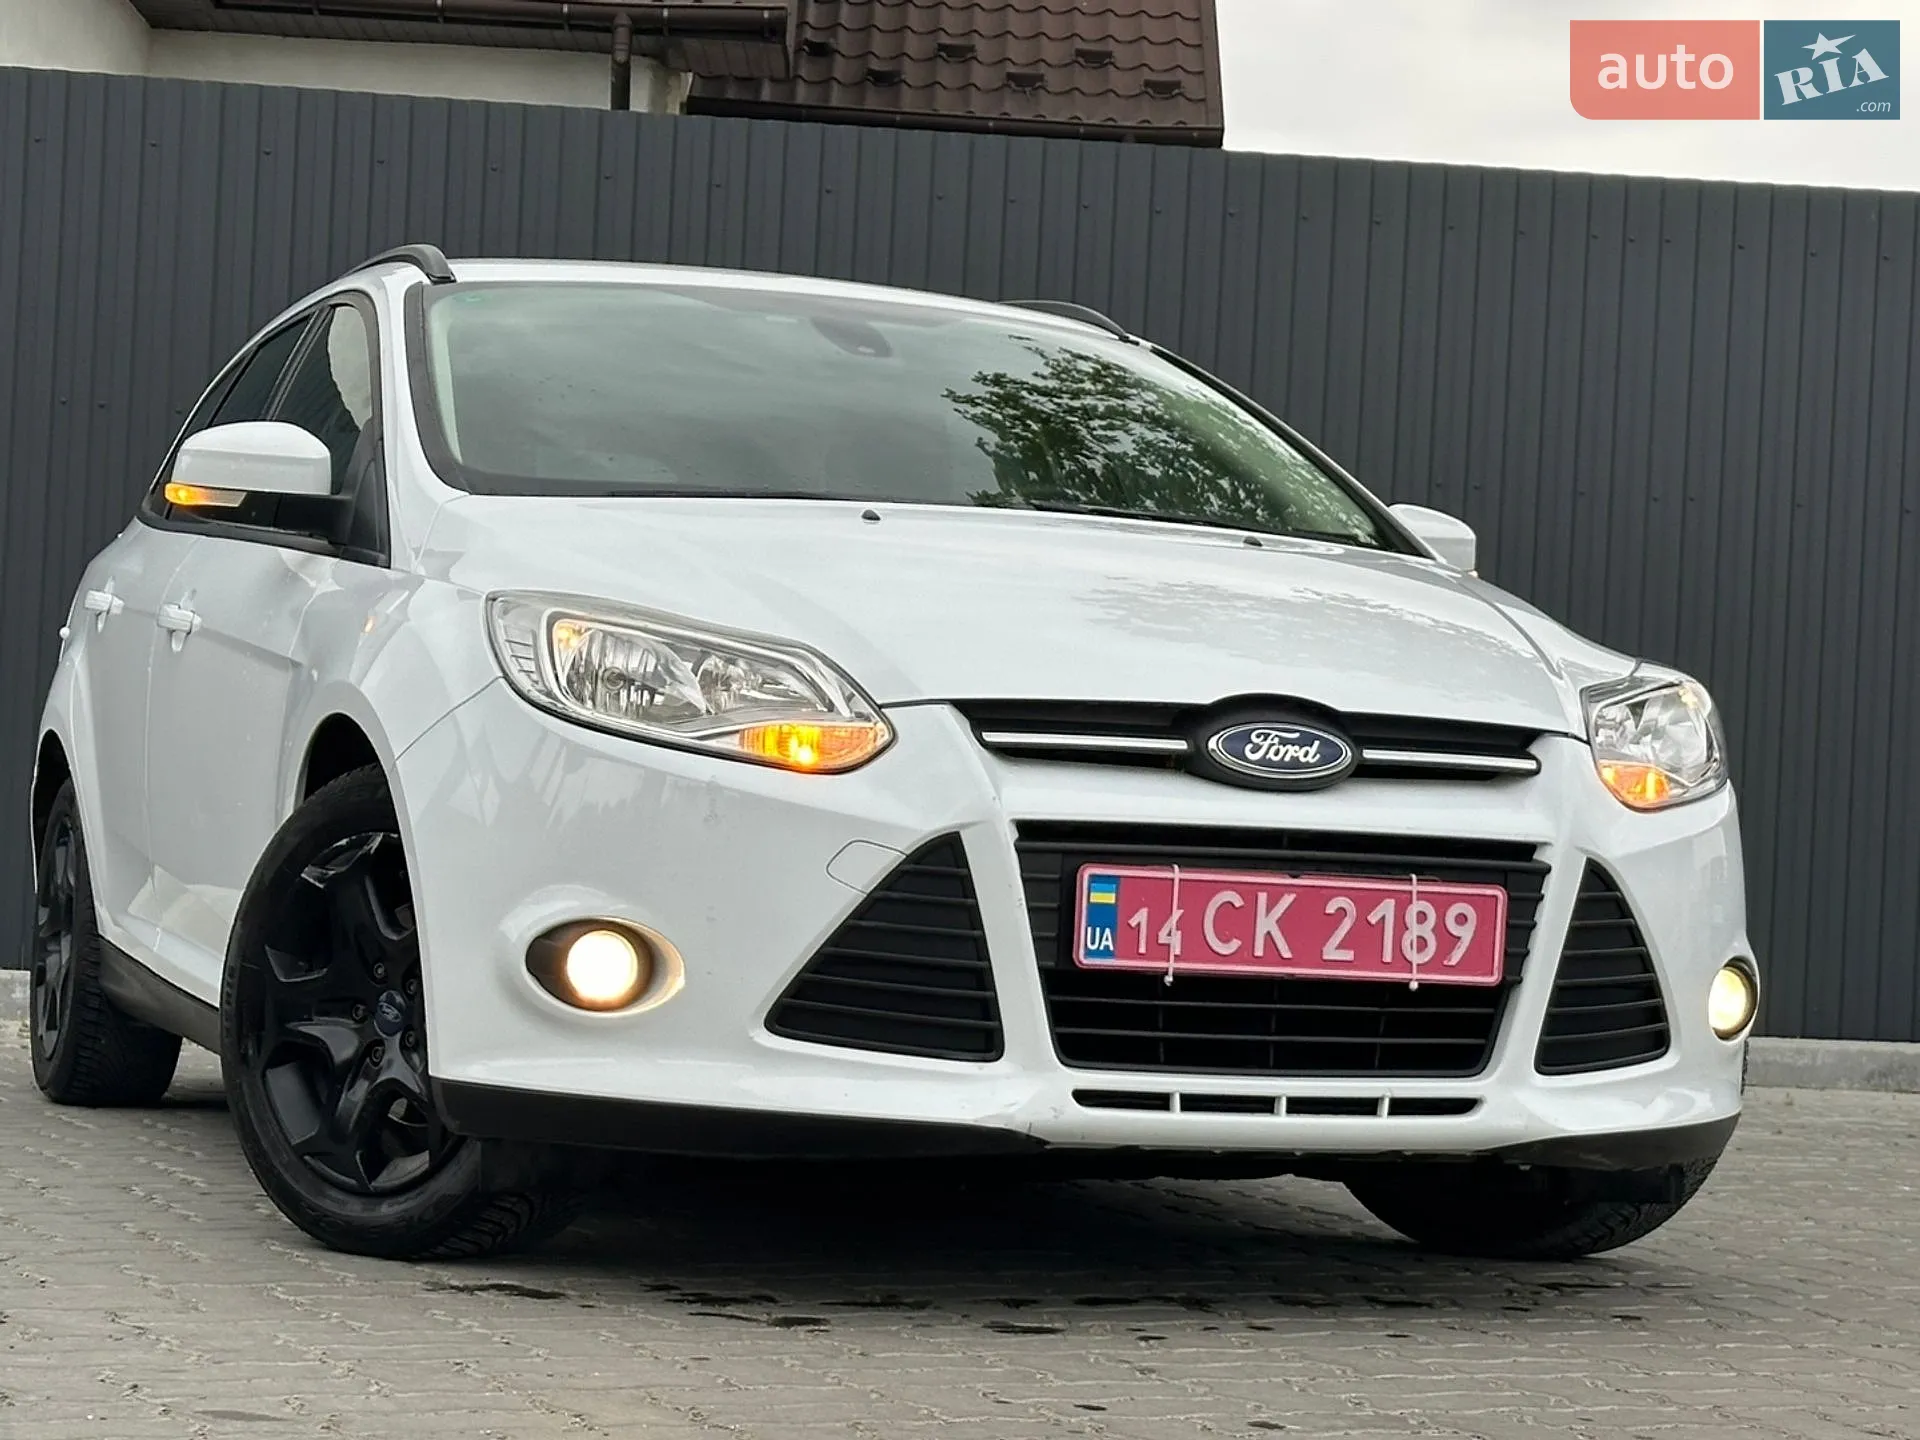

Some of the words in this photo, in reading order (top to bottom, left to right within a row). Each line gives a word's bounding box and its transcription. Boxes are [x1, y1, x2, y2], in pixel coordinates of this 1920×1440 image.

[1244, 729, 1320, 763] Ford
[1087, 926, 1114, 951] UA
[1127, 907, 1184, 956] 14
[1203, 890, 1297, 959] CK
[1321, 896, 1478, 967] 2189
